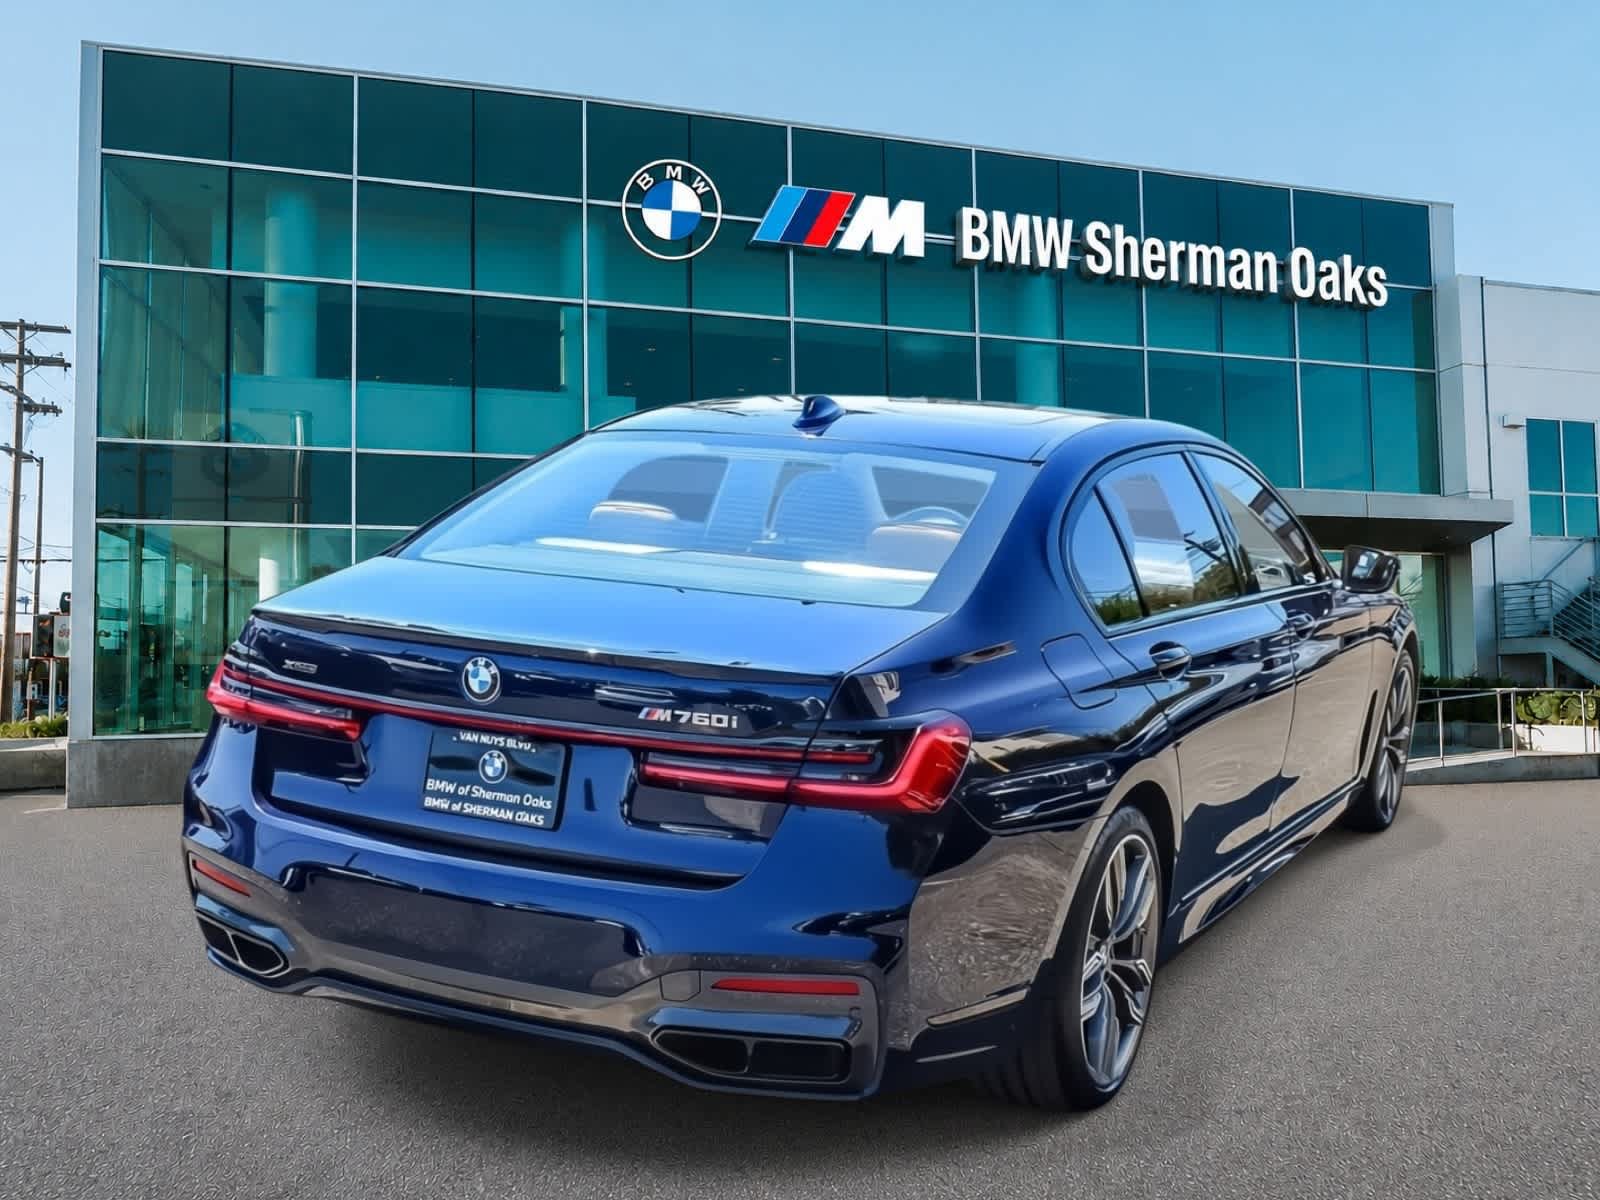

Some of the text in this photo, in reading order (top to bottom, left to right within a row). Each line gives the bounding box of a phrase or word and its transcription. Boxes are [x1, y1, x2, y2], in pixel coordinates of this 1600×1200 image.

[957, 206, 1389, 308] BMW Sherman Oaks
[459, 731, 479, 743] VAN
[479, 734, 504, 747] NUYS
[426, 778, 553, 810] BMW of Sherman Oaks
[424, 796, 451, 810] BMW
[451, 801, 461, 811] of
[463, 802, 513, 821] SHERMAN
